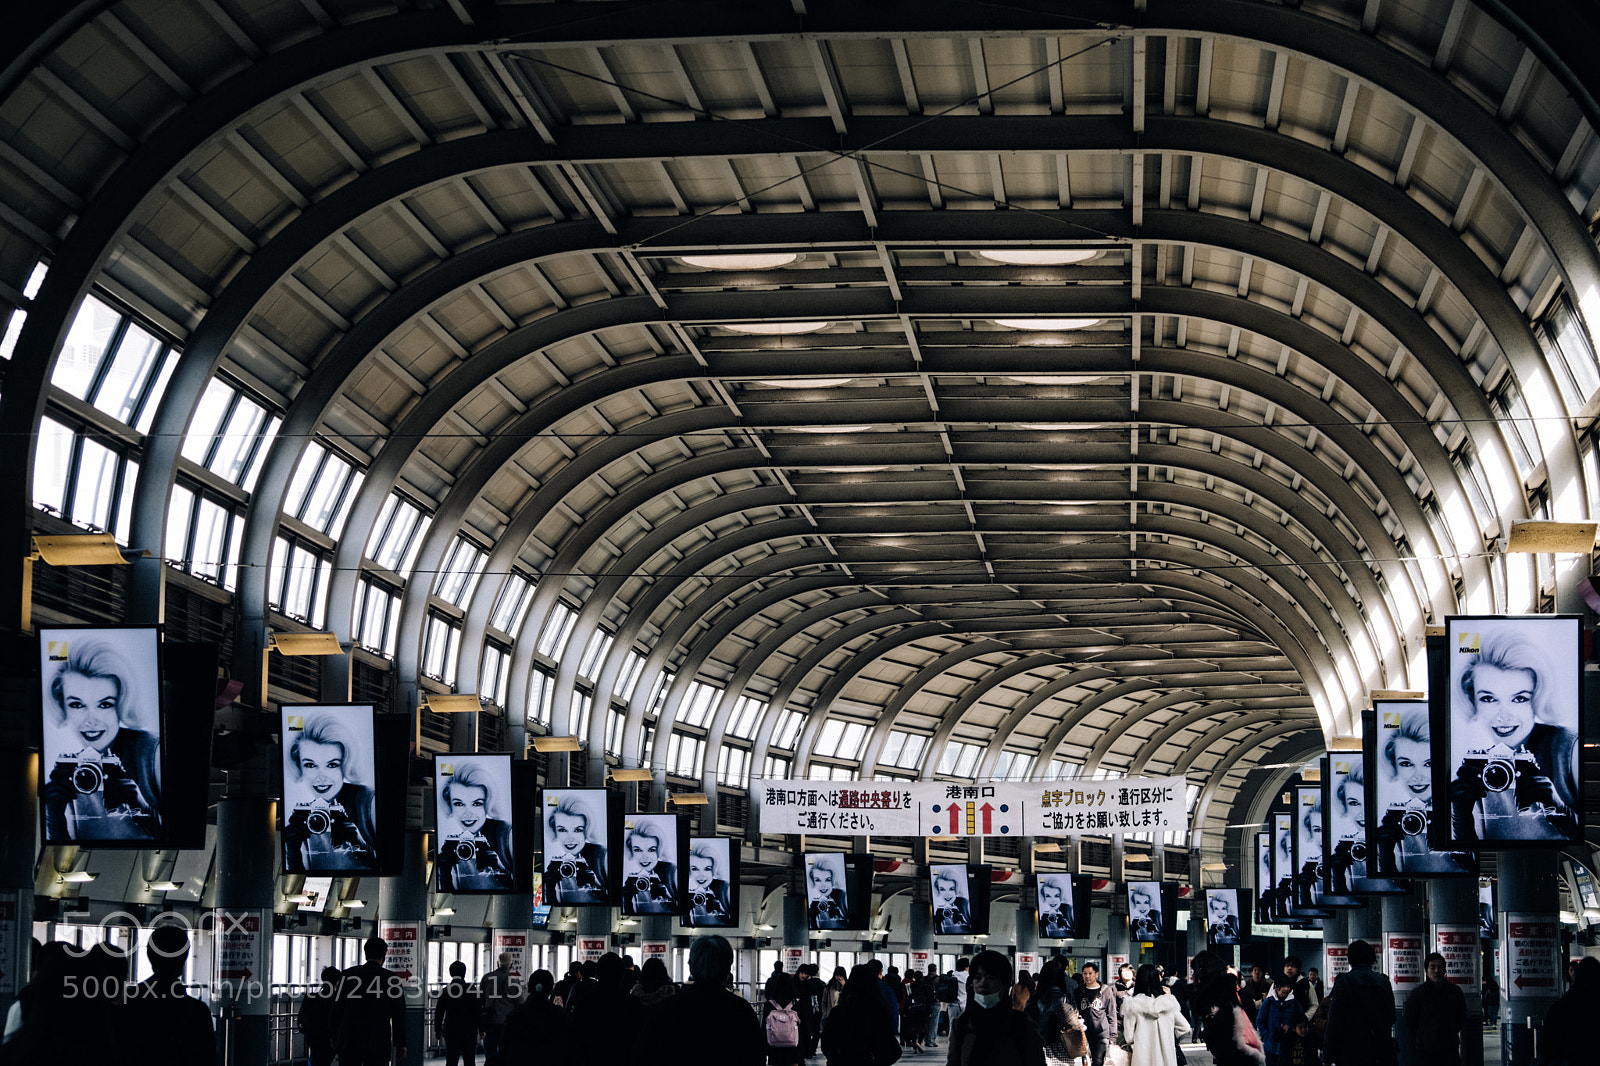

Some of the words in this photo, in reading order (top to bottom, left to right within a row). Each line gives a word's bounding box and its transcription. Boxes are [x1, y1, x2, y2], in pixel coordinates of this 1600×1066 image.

[765, 787, 912, 809] 港南口方面へは通路中央寄りを
[945, 785, 995, 799] 港南口
[1041, 787, 1174, 808] 点字ブロック・通行区分に
[797, 811, 875, 830] ご通行ください。
[1042, 808, 1168, 830] ご協力をお願い致します。
